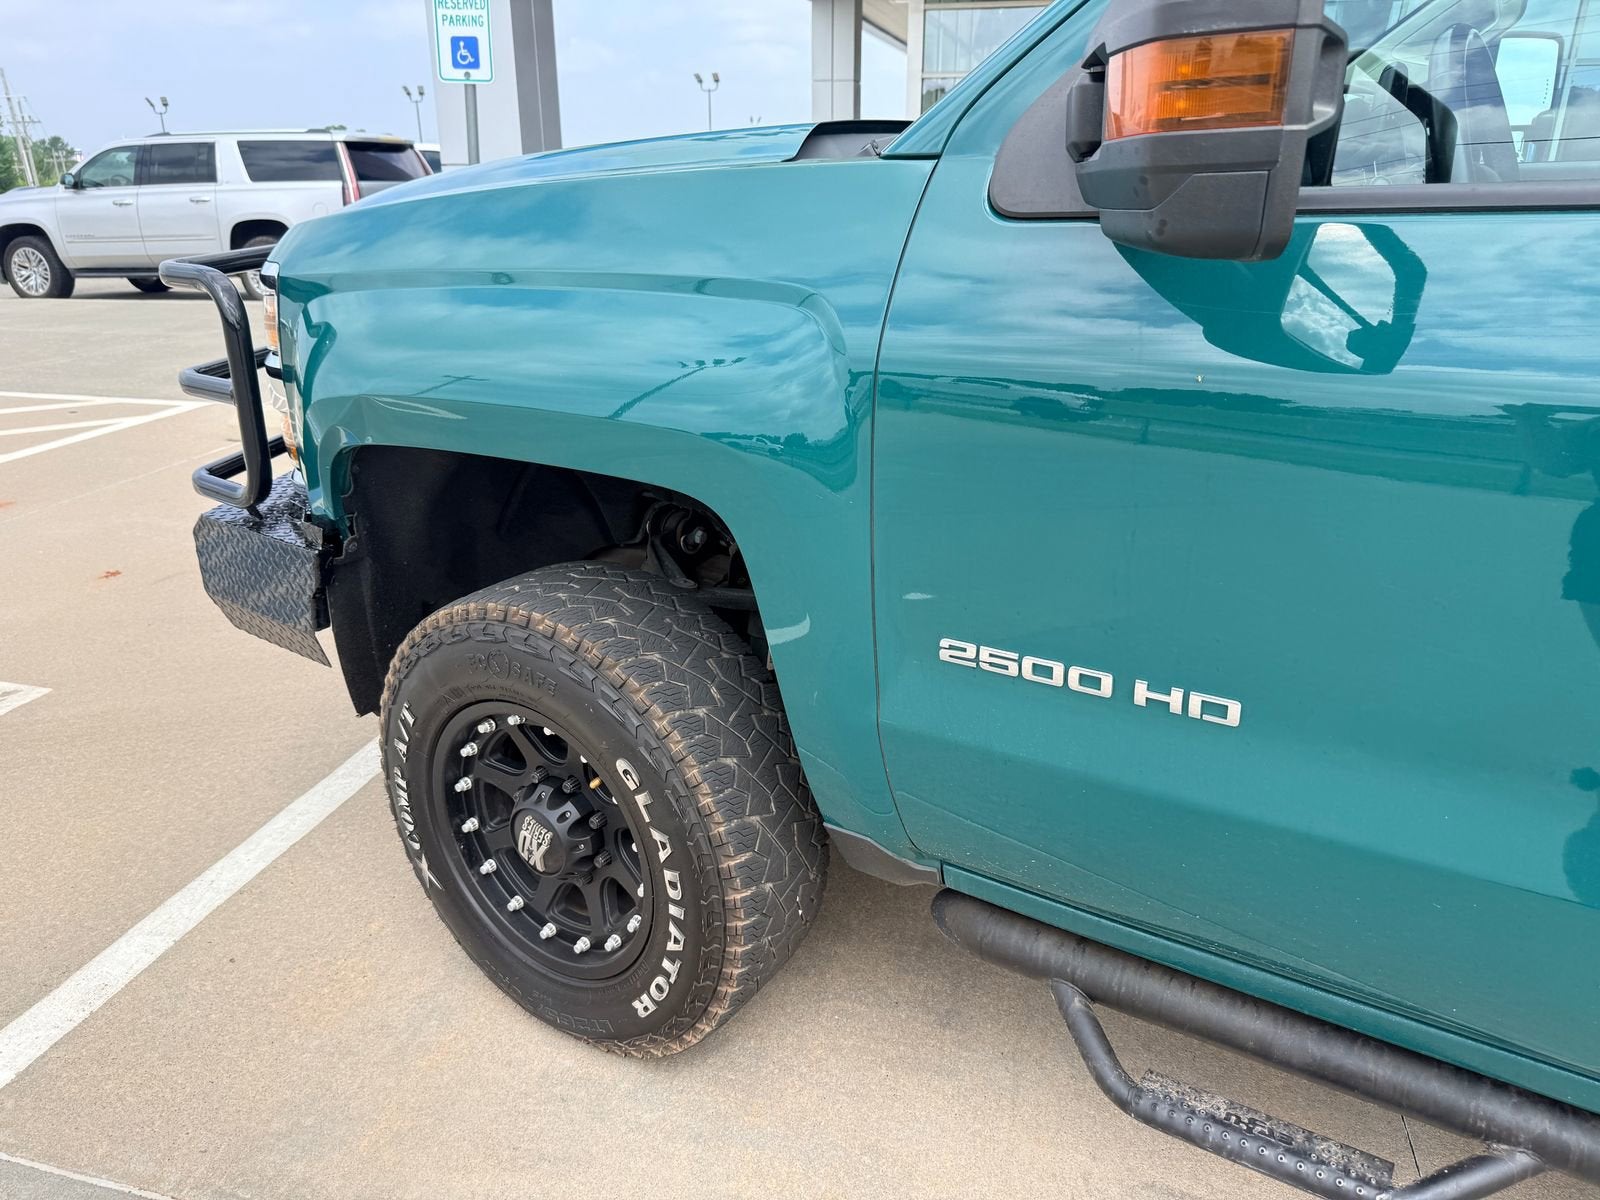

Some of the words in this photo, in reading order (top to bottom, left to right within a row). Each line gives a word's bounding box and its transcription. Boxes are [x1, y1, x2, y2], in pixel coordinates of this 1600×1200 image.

[438, 0, 486, 10] RESERVED
[442, 14, 484, 27] PARKING
[939, 637, 1113, 698] 2500
[1134, 679, 1242, 727] HD
[394, 702, 416, 763] A/T
[522, 815, 553, 847] SERIES
[616, 757, 685, 1018] GLADIATOR
